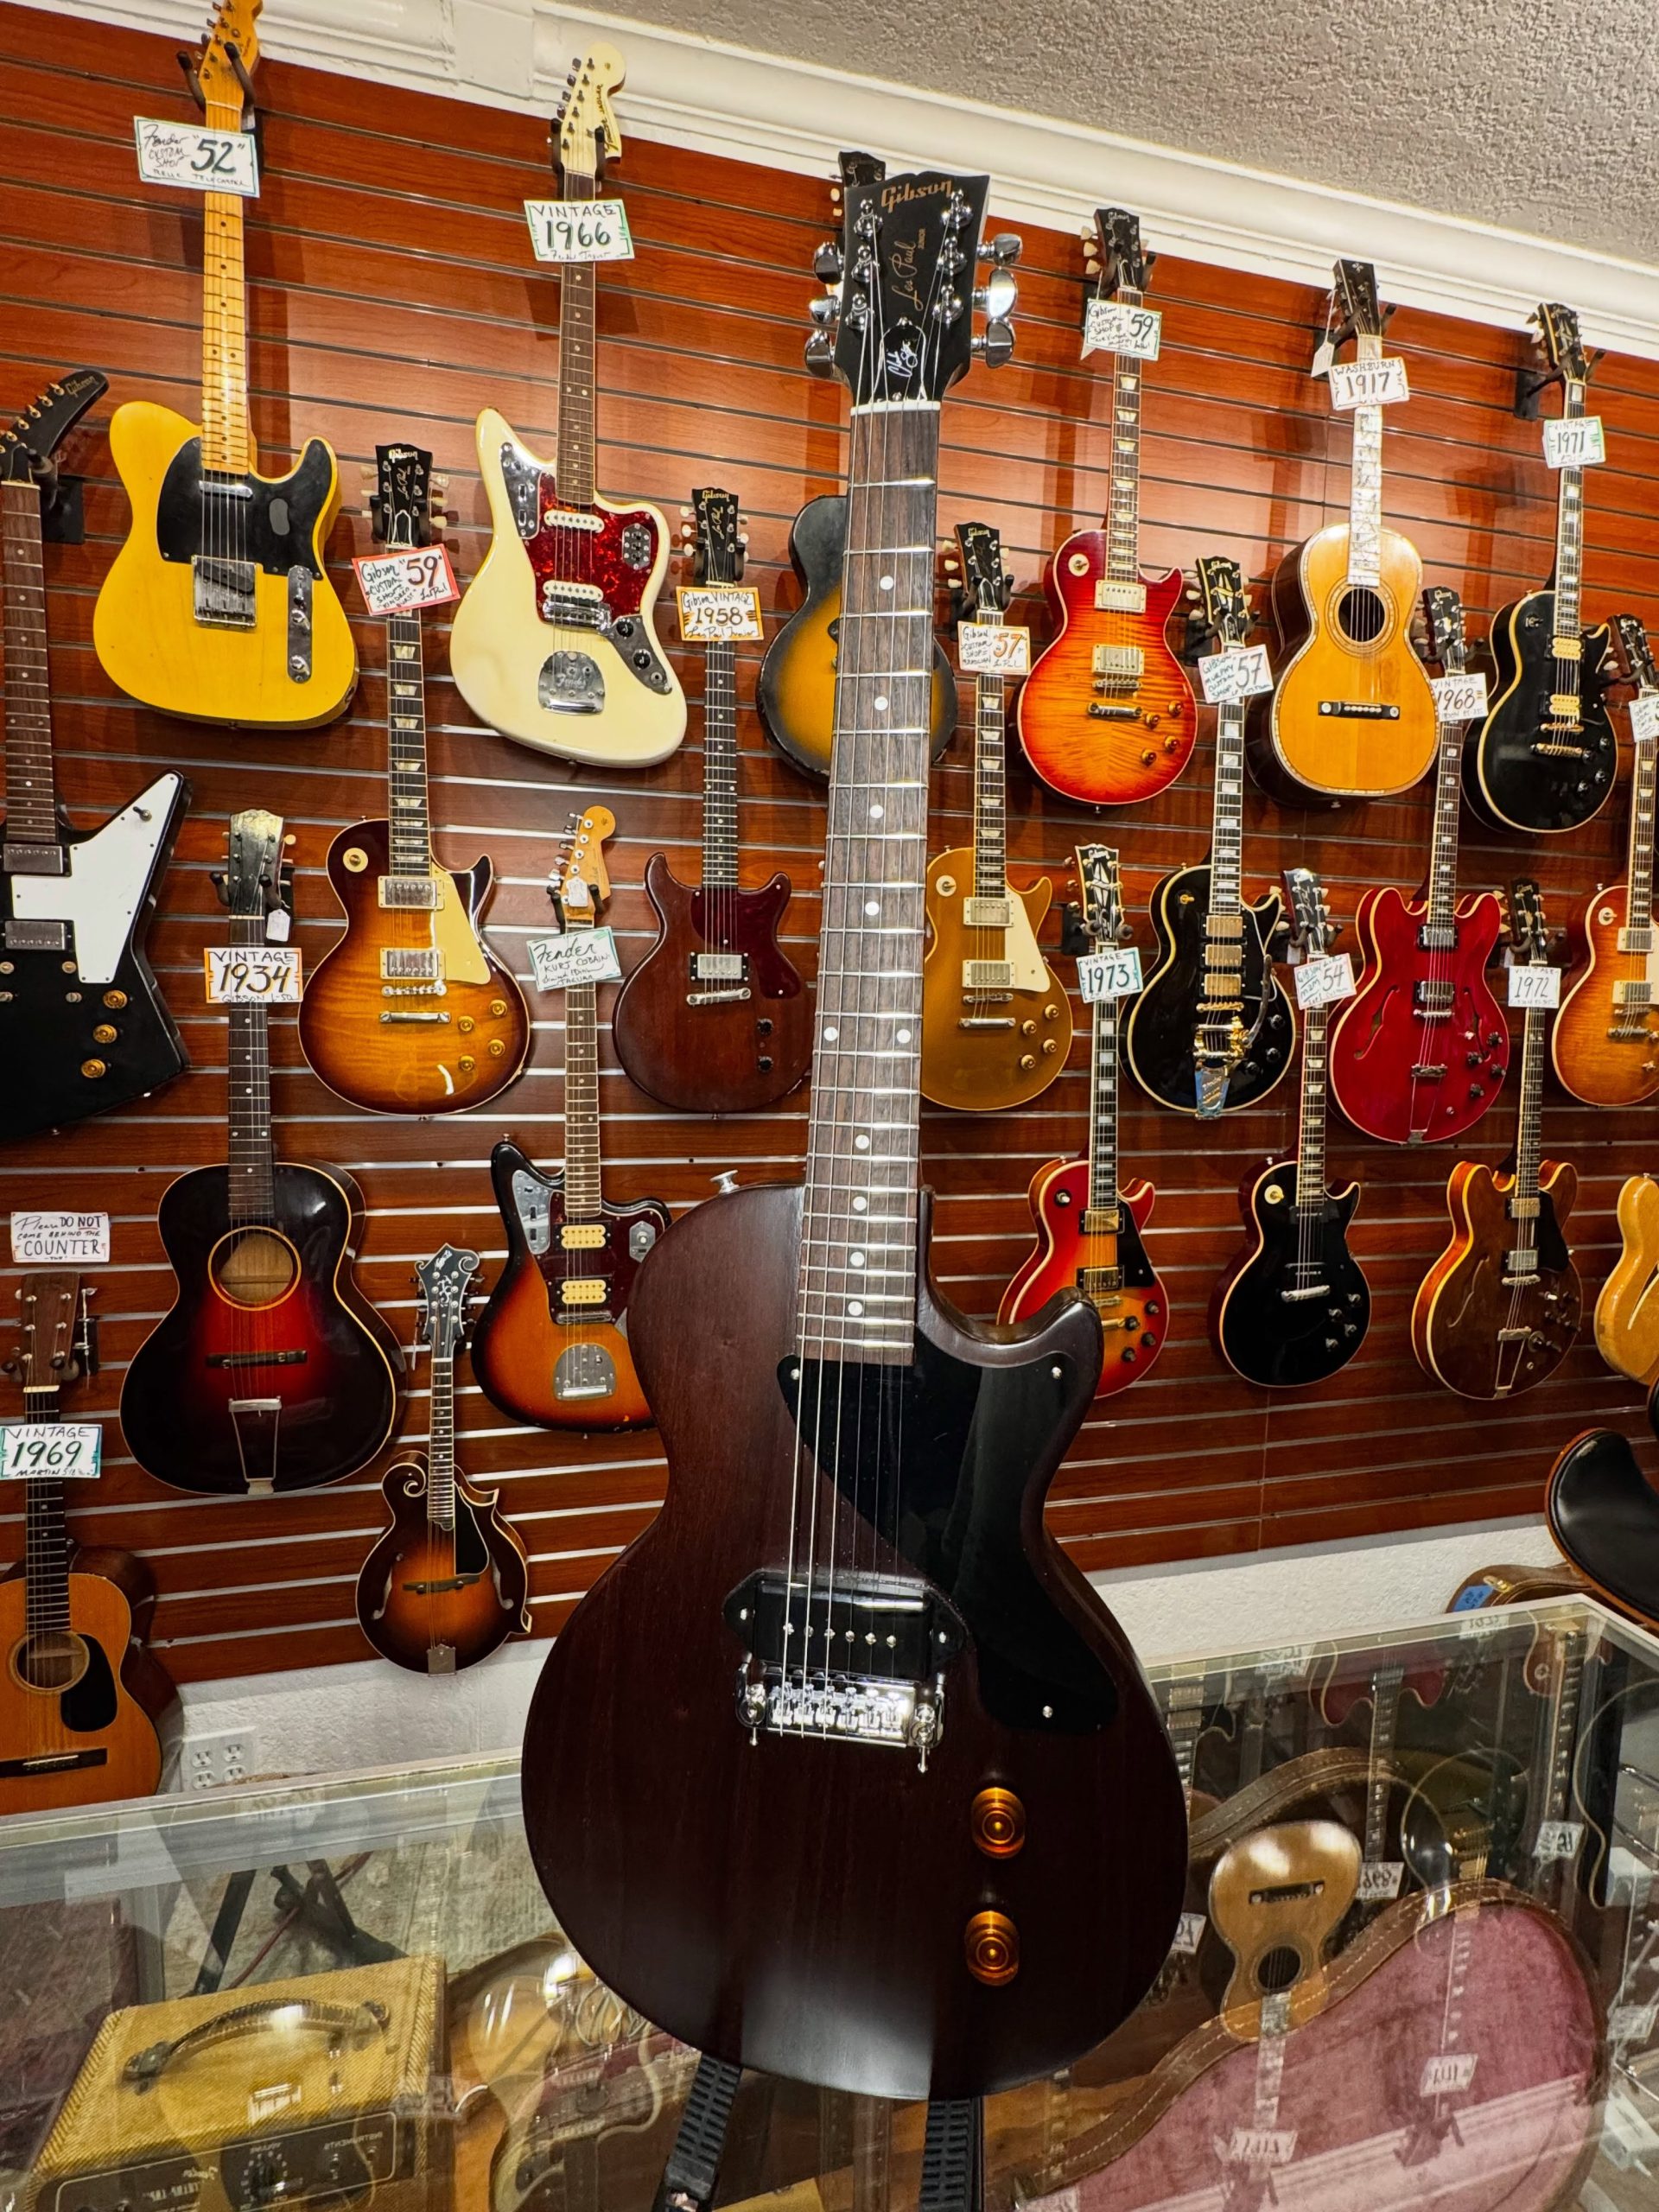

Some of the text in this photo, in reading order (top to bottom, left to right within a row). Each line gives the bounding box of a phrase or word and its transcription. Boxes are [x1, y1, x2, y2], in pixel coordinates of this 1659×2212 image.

[143, 124, 189, 150] Fender
[149, 147, 189, 160] CUSTOM
[880, 180, 952, 213] Gibson
[531, 204, 617, 218] VINTAGE
[546, 220, 611, 250] 1966
[888, 241, 918, 279] Paul
[891, 278, 924, 312] Les
[1334, 359, 1395, 375] WASHBURN
[1346, 371, 1390, 397] 1917
[1557, 430, 1586, 454] 1971
[388, 448, 419, 463] Gibson
[702, 490, 730, 503] Gibson
[361, 563, 400, 582] Gibson
[683, 591, 753, 611] Gibson VINTAGE
[695, 607, 743, 626] 1958
[1438, 688, 1475, 710] 1968
[213, 950, 296, 965] VINTAGE
[533, 938, 596, 963] Fender
[1083, 952, 1122, 966] VINTAGE
[544, 960, 571, 974] KURT
[219, 963, 291, 994] 1934
[1088, 964, 1130, 994] 1973
[1514, 976, 1549, 998] 1972
[221, 994, 265, 1002] GIBSON
[15, 1215, 102, 1230] Please DO NOT
[24, 1239, 101, 1256] COUNTER
[6, 1427, 90, 1439] VINTAGE
[11, 1440, 82, 1467] 1969
[16, 1468, 60, 1477] MARTIN
